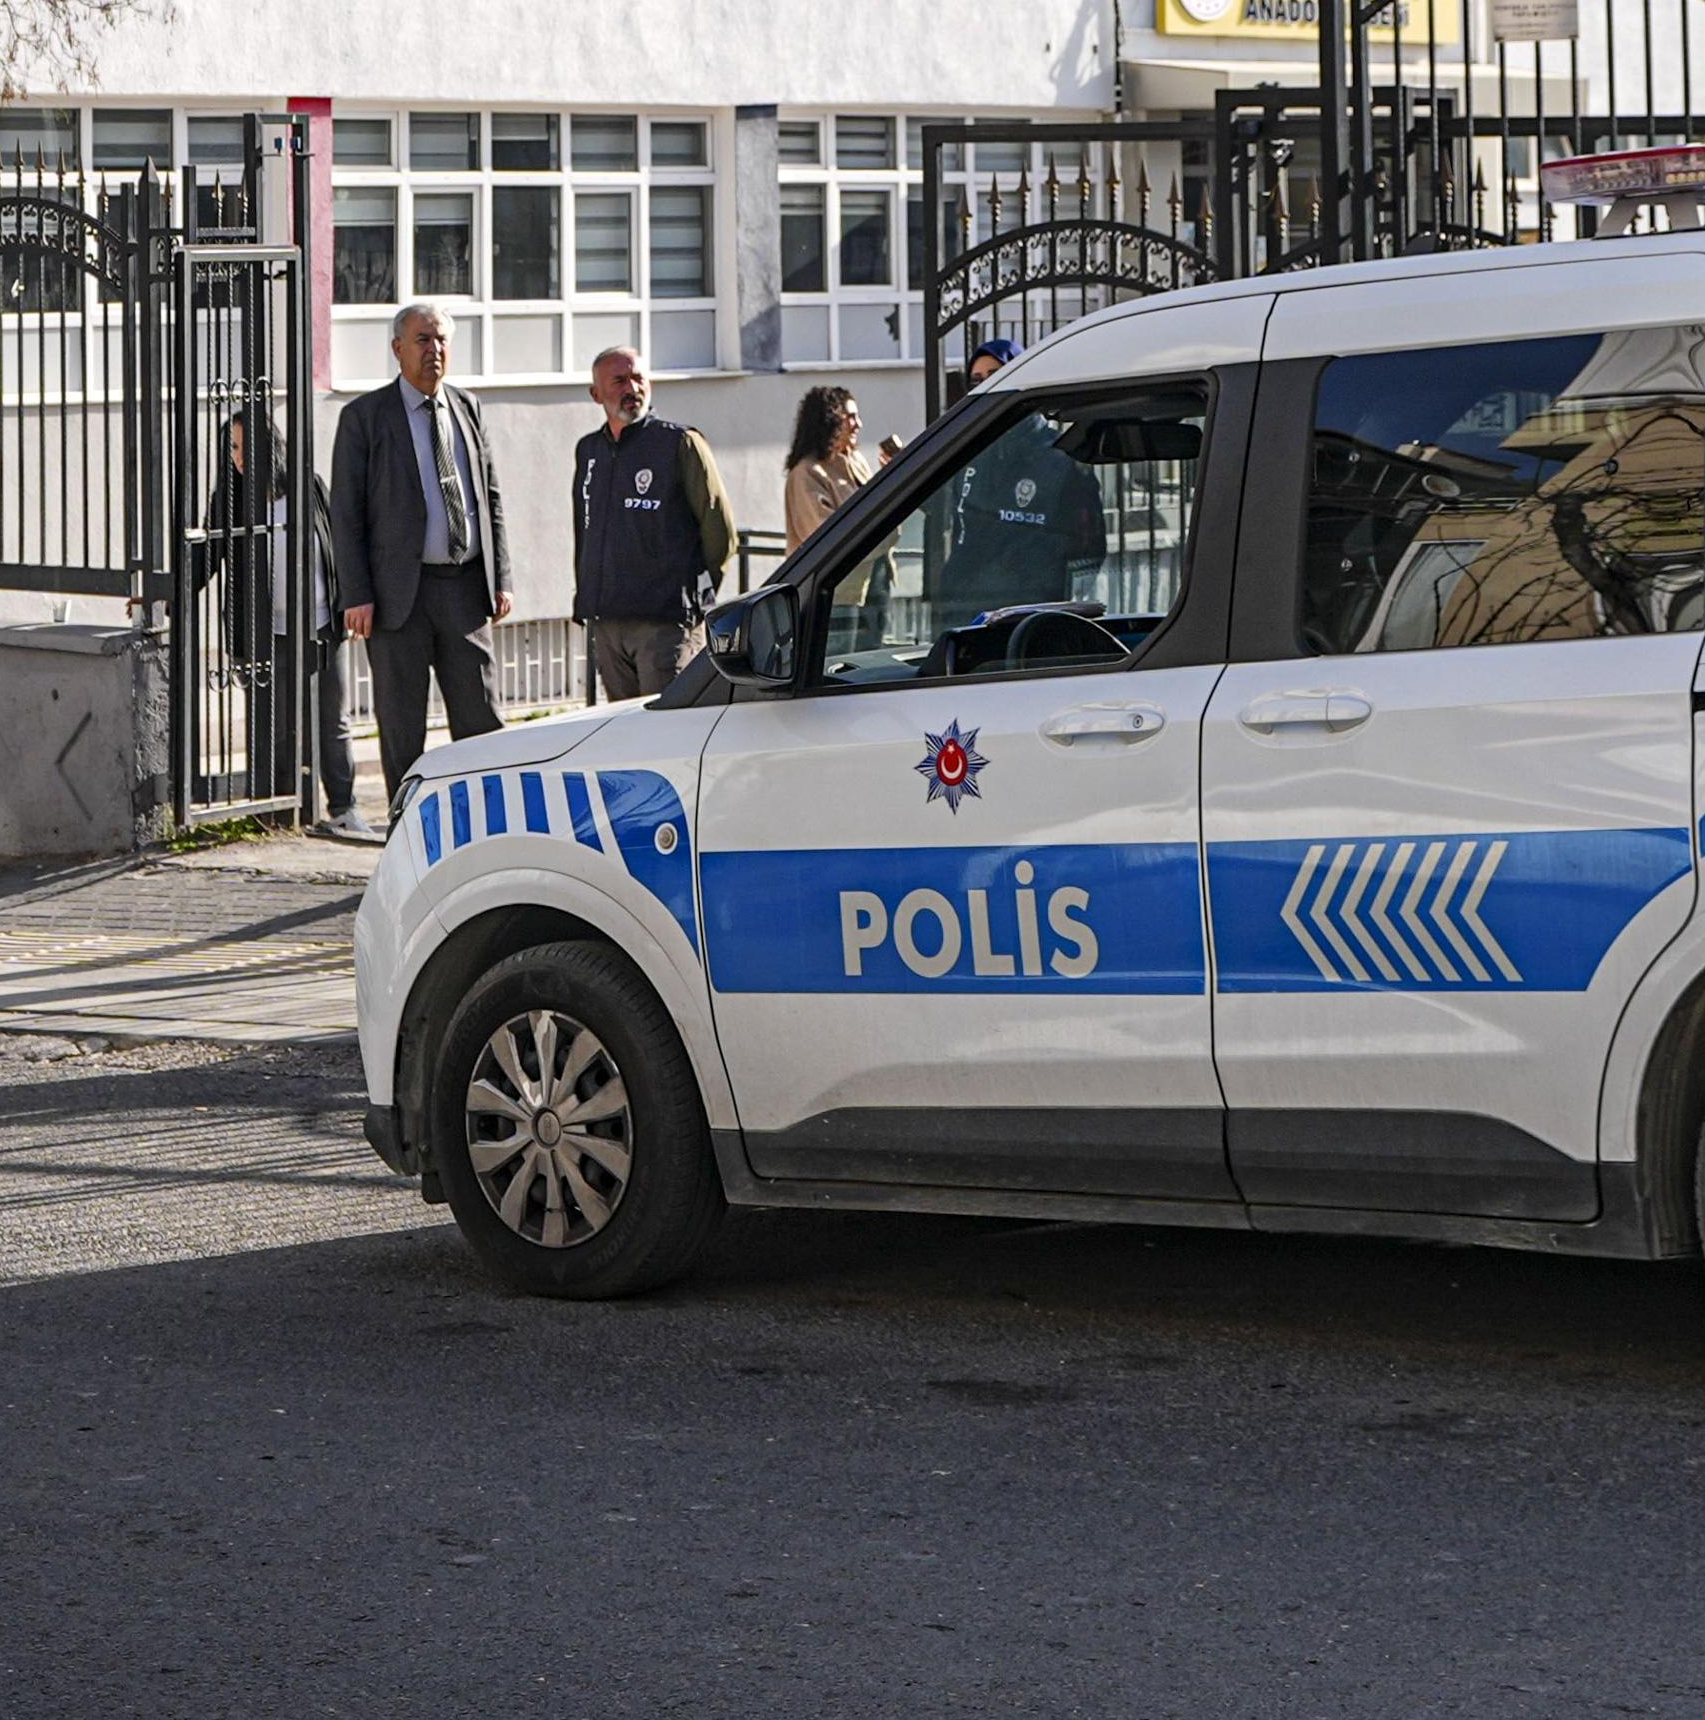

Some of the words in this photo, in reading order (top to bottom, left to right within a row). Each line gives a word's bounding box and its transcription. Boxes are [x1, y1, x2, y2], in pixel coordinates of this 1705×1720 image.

[624, 497, 661, 510] 9797
[999, 508, 1046, 525] 10532
[839, 859, 1099, 978] POLİS
